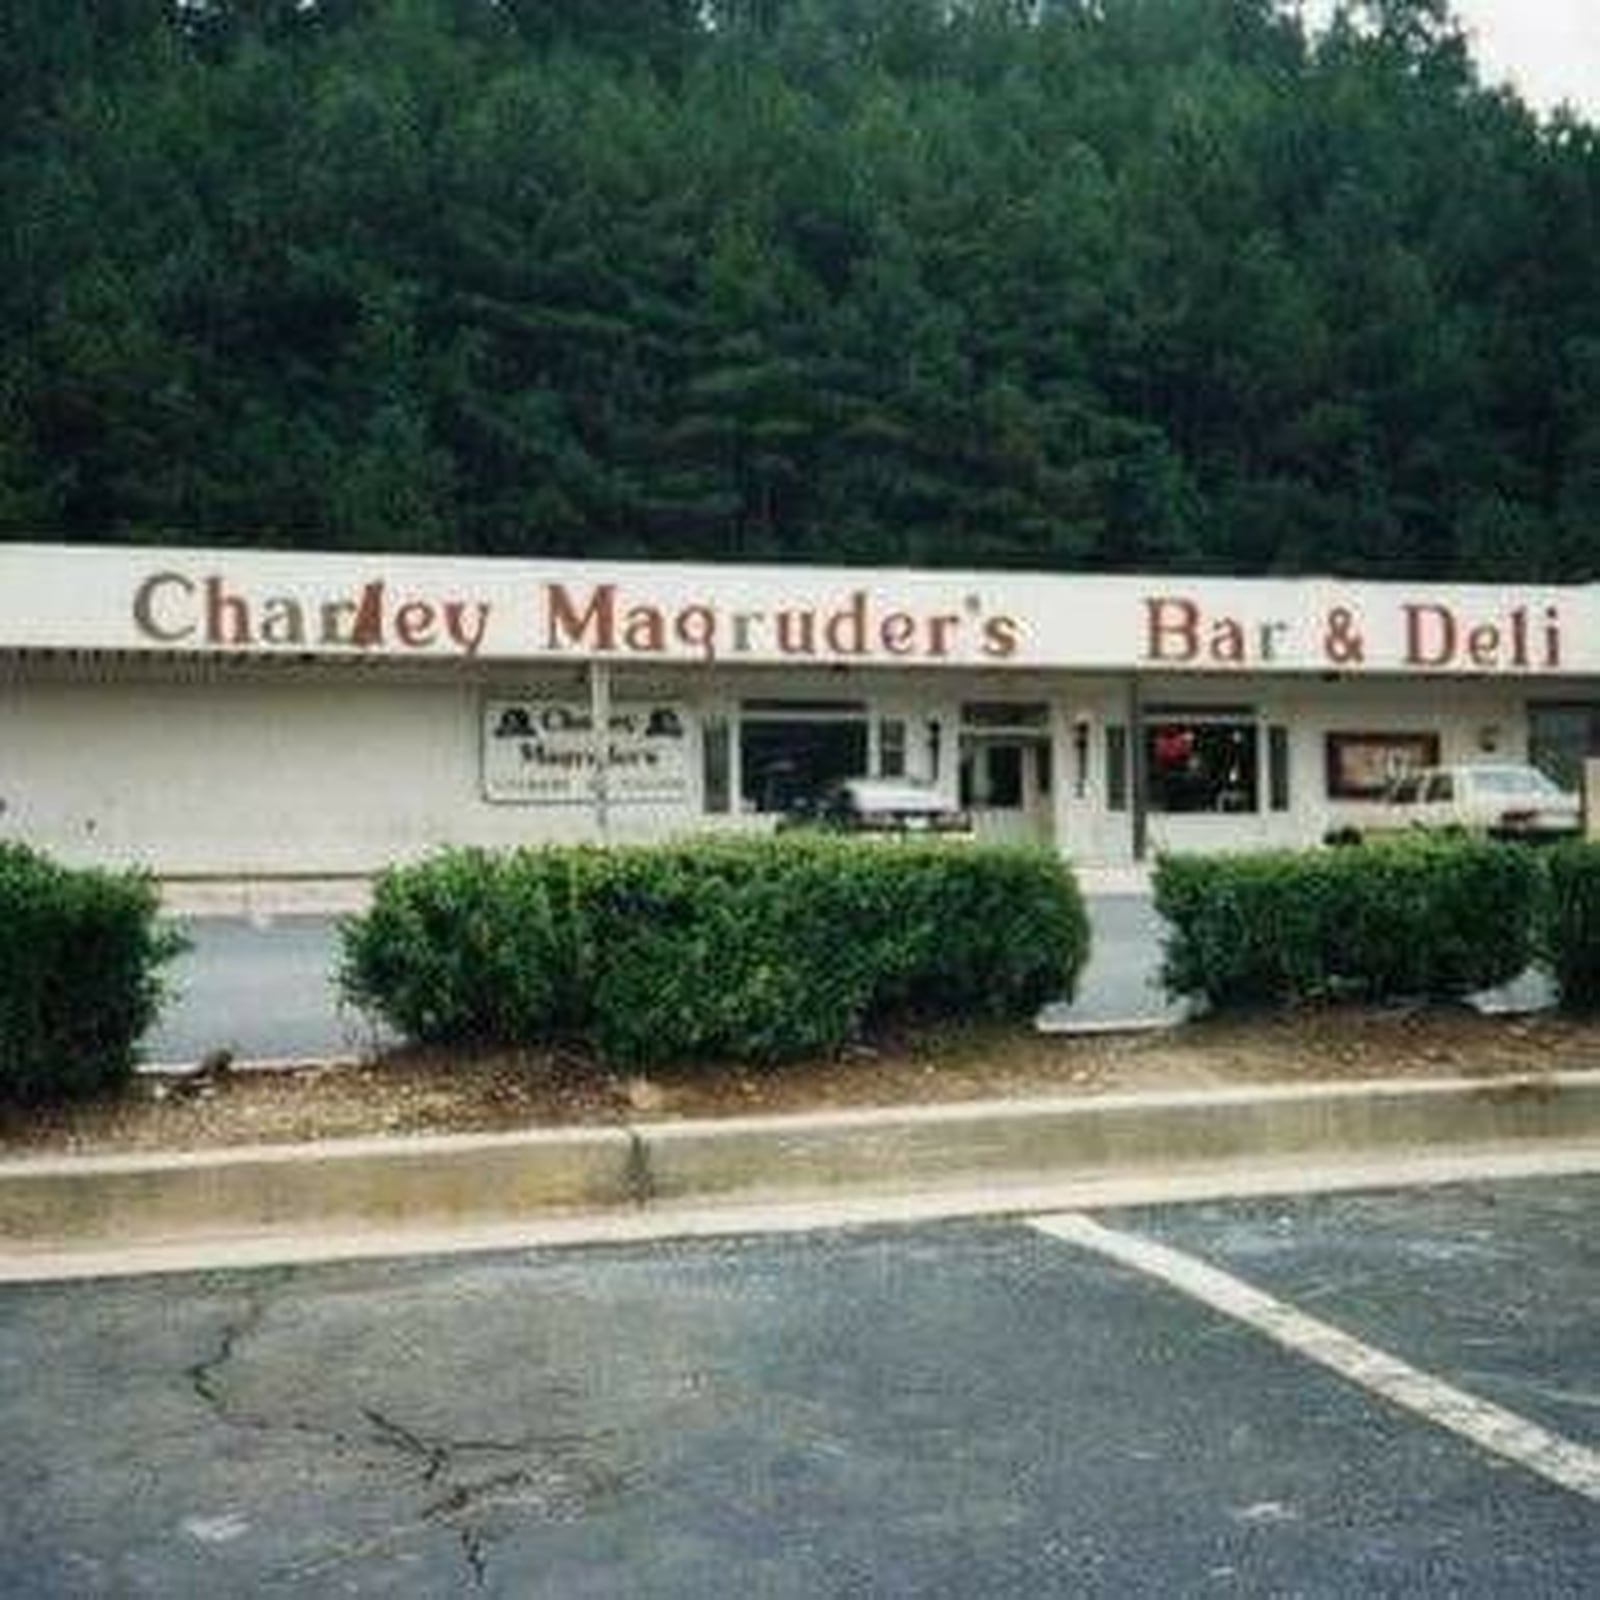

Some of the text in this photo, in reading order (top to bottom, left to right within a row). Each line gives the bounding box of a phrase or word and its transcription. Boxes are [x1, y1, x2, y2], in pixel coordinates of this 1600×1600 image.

[133, 571, 1560, 667] Charley Magruder's Bar & Deli
